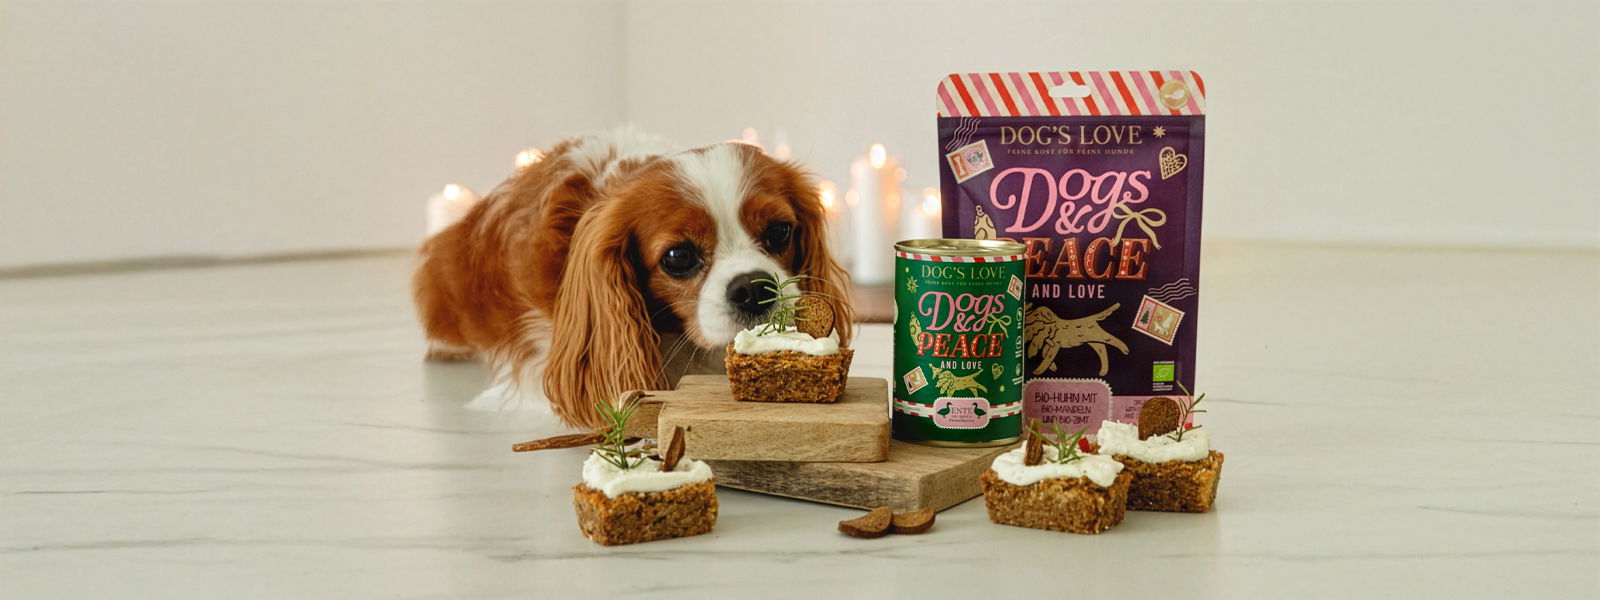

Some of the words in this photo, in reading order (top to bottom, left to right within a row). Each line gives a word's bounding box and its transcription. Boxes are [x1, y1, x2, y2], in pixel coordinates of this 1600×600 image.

[1000, 126, 1071, 145] DOG'S
[1079, 125, 1142, 145] LOVE
[989, 167, 1152, 234] Dogs
[1055, 201, 1093, 235] &
[996, 237, 1150, 281] EACE
[921, 264, 965, 280] DOG'S
[971, 265, 1006, 280] LOVE
[1031, 284, 1061, 299] AND
[1068, 284, 1105, 299] LOVE
[918, 290, 1006, 332] Dogs
[953, 312, 975, 333] &
[916, 332, 1006, 358] PEACE
[940, 360, 957, 370] AND
[961, 360, 982, 370] LOVE
[1034, 392, 1080, 403] BIO-HUHN
[1082, 392, 1098, 403] MIT
[951, 407, 973, 415] ENTE
[1041, 405, 1092, 414] BIO-MANDELN
[1042, 415, 1057, 425] UND
